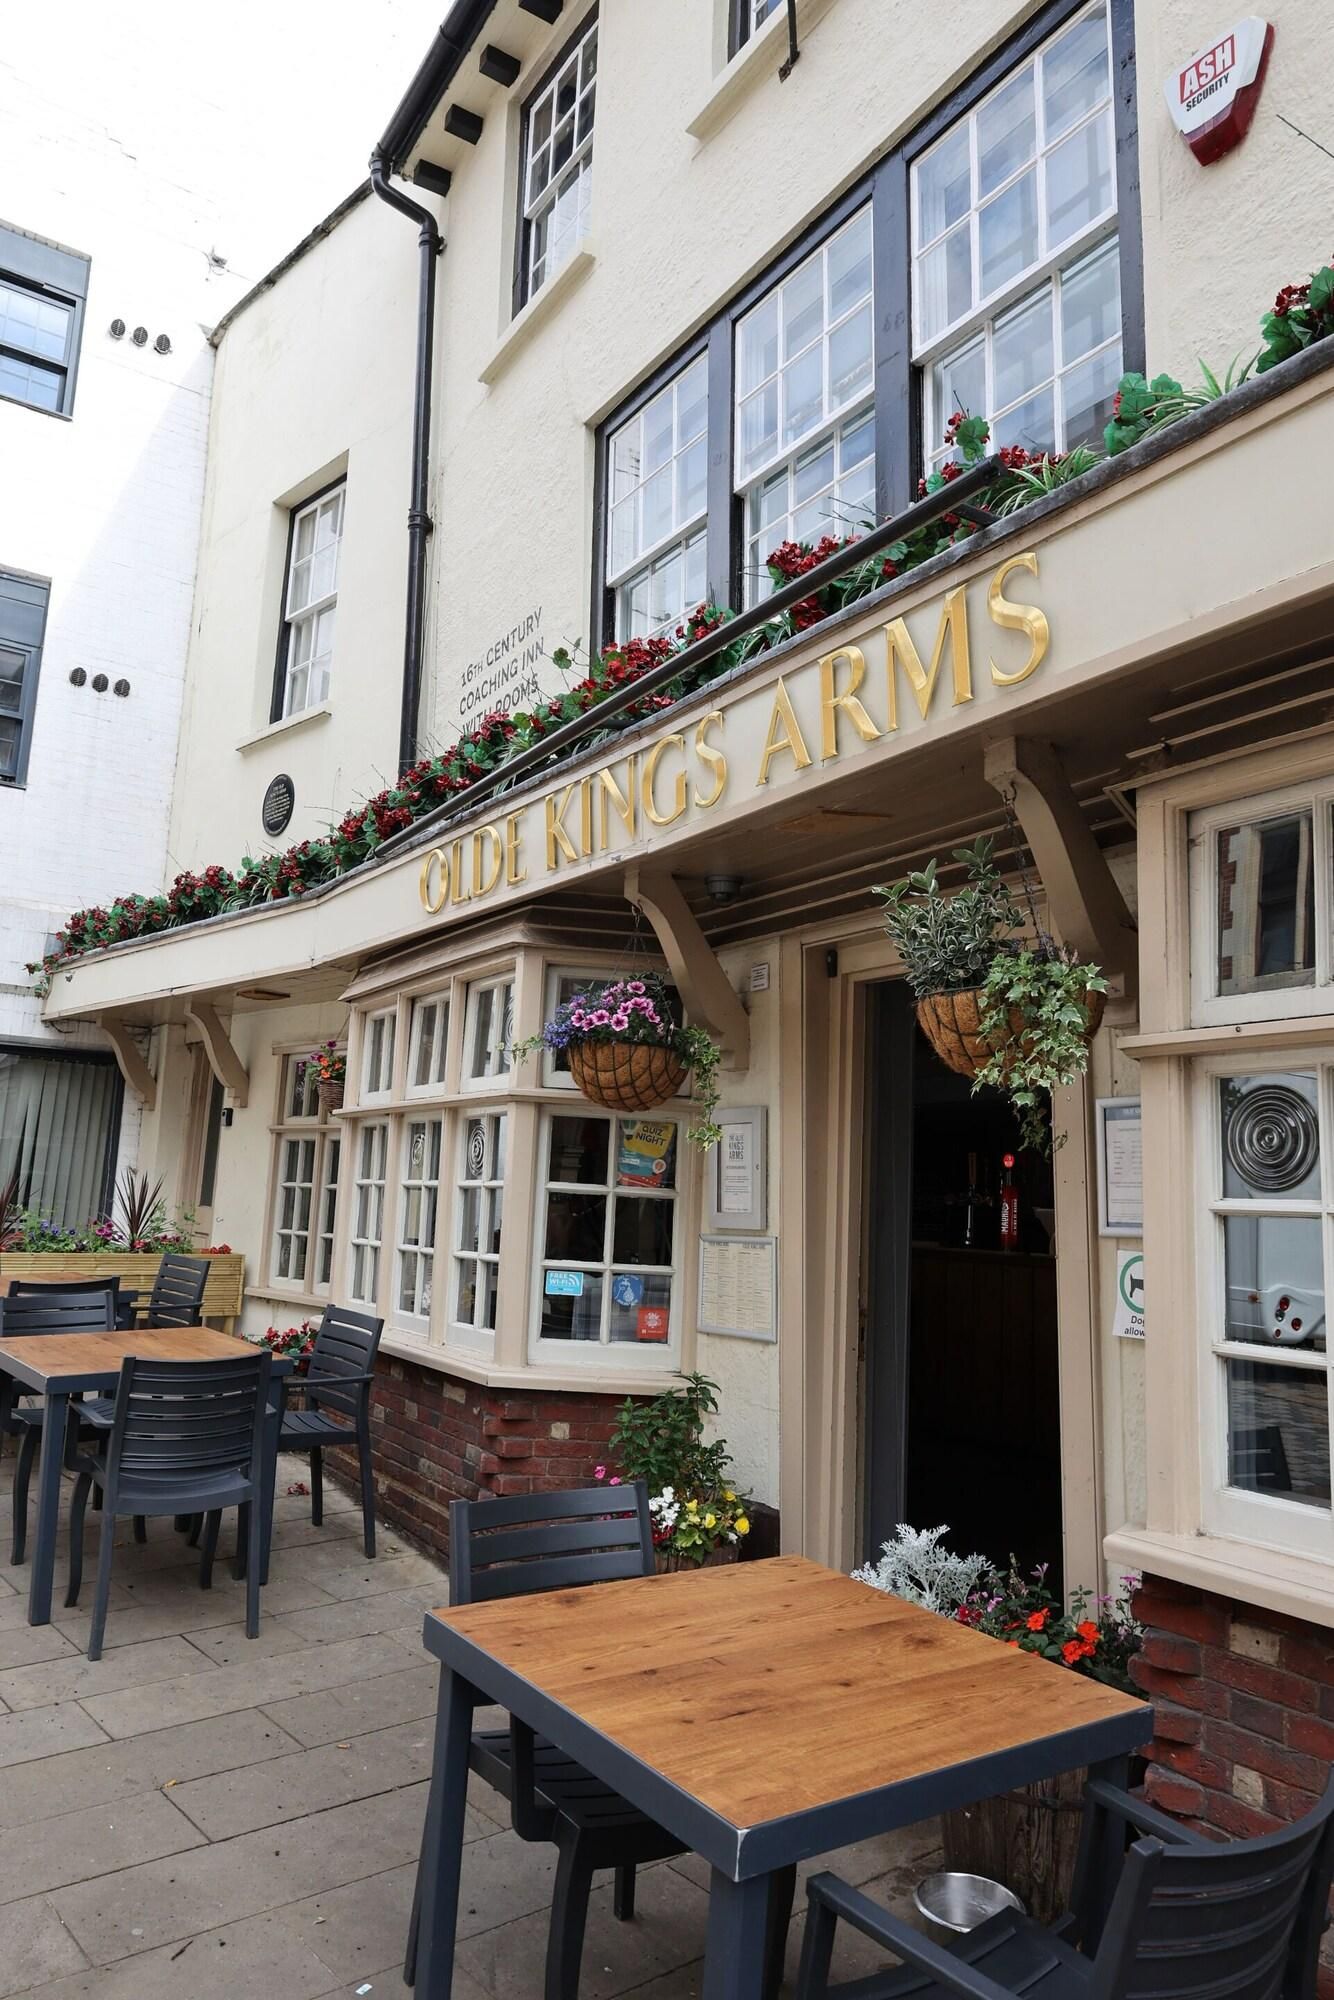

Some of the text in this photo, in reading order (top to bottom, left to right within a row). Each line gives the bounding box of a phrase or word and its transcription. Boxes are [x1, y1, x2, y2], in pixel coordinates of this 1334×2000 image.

[1183, 37, 1233, 101] ASH
[1186, 72, 1230, 112] SECURITY
[486, 606, 542, 667] CENTURY
[460, 636, 544, 715] COACHING INN
[419, 551, 1051, 915] OLDE KINGS ARMS
[642, 1125, 664, 1136] QUIZ
